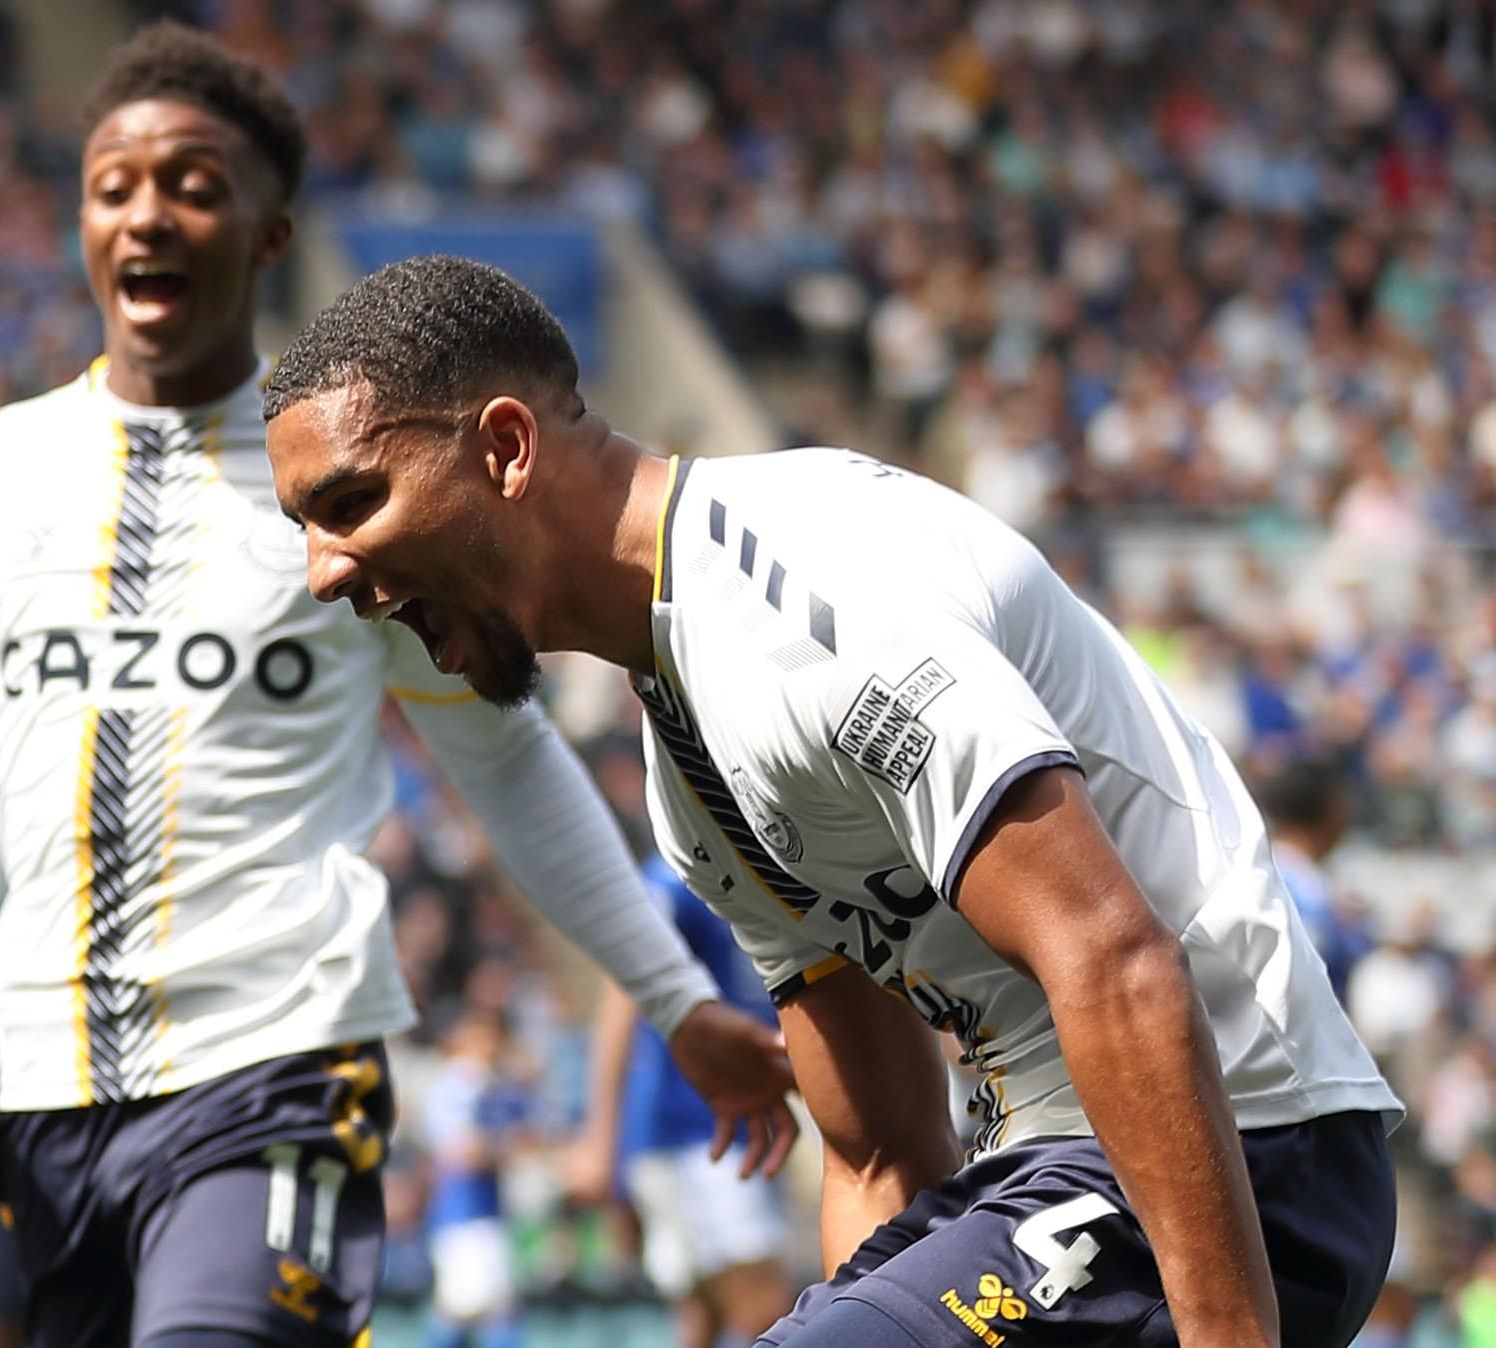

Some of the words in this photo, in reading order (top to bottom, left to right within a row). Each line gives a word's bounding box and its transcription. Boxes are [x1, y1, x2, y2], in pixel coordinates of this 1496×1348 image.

[1, 629, 315, 701] CAZOO
[840, 684, 891, 756] UKRAINE
[862, 667, 944, 770] HUMANITARIAN
[886, 726, 929, 787] APPEAL
[260, 1143, 348, 1275] 11
[1013, 1192, 1120, 1311] 4
